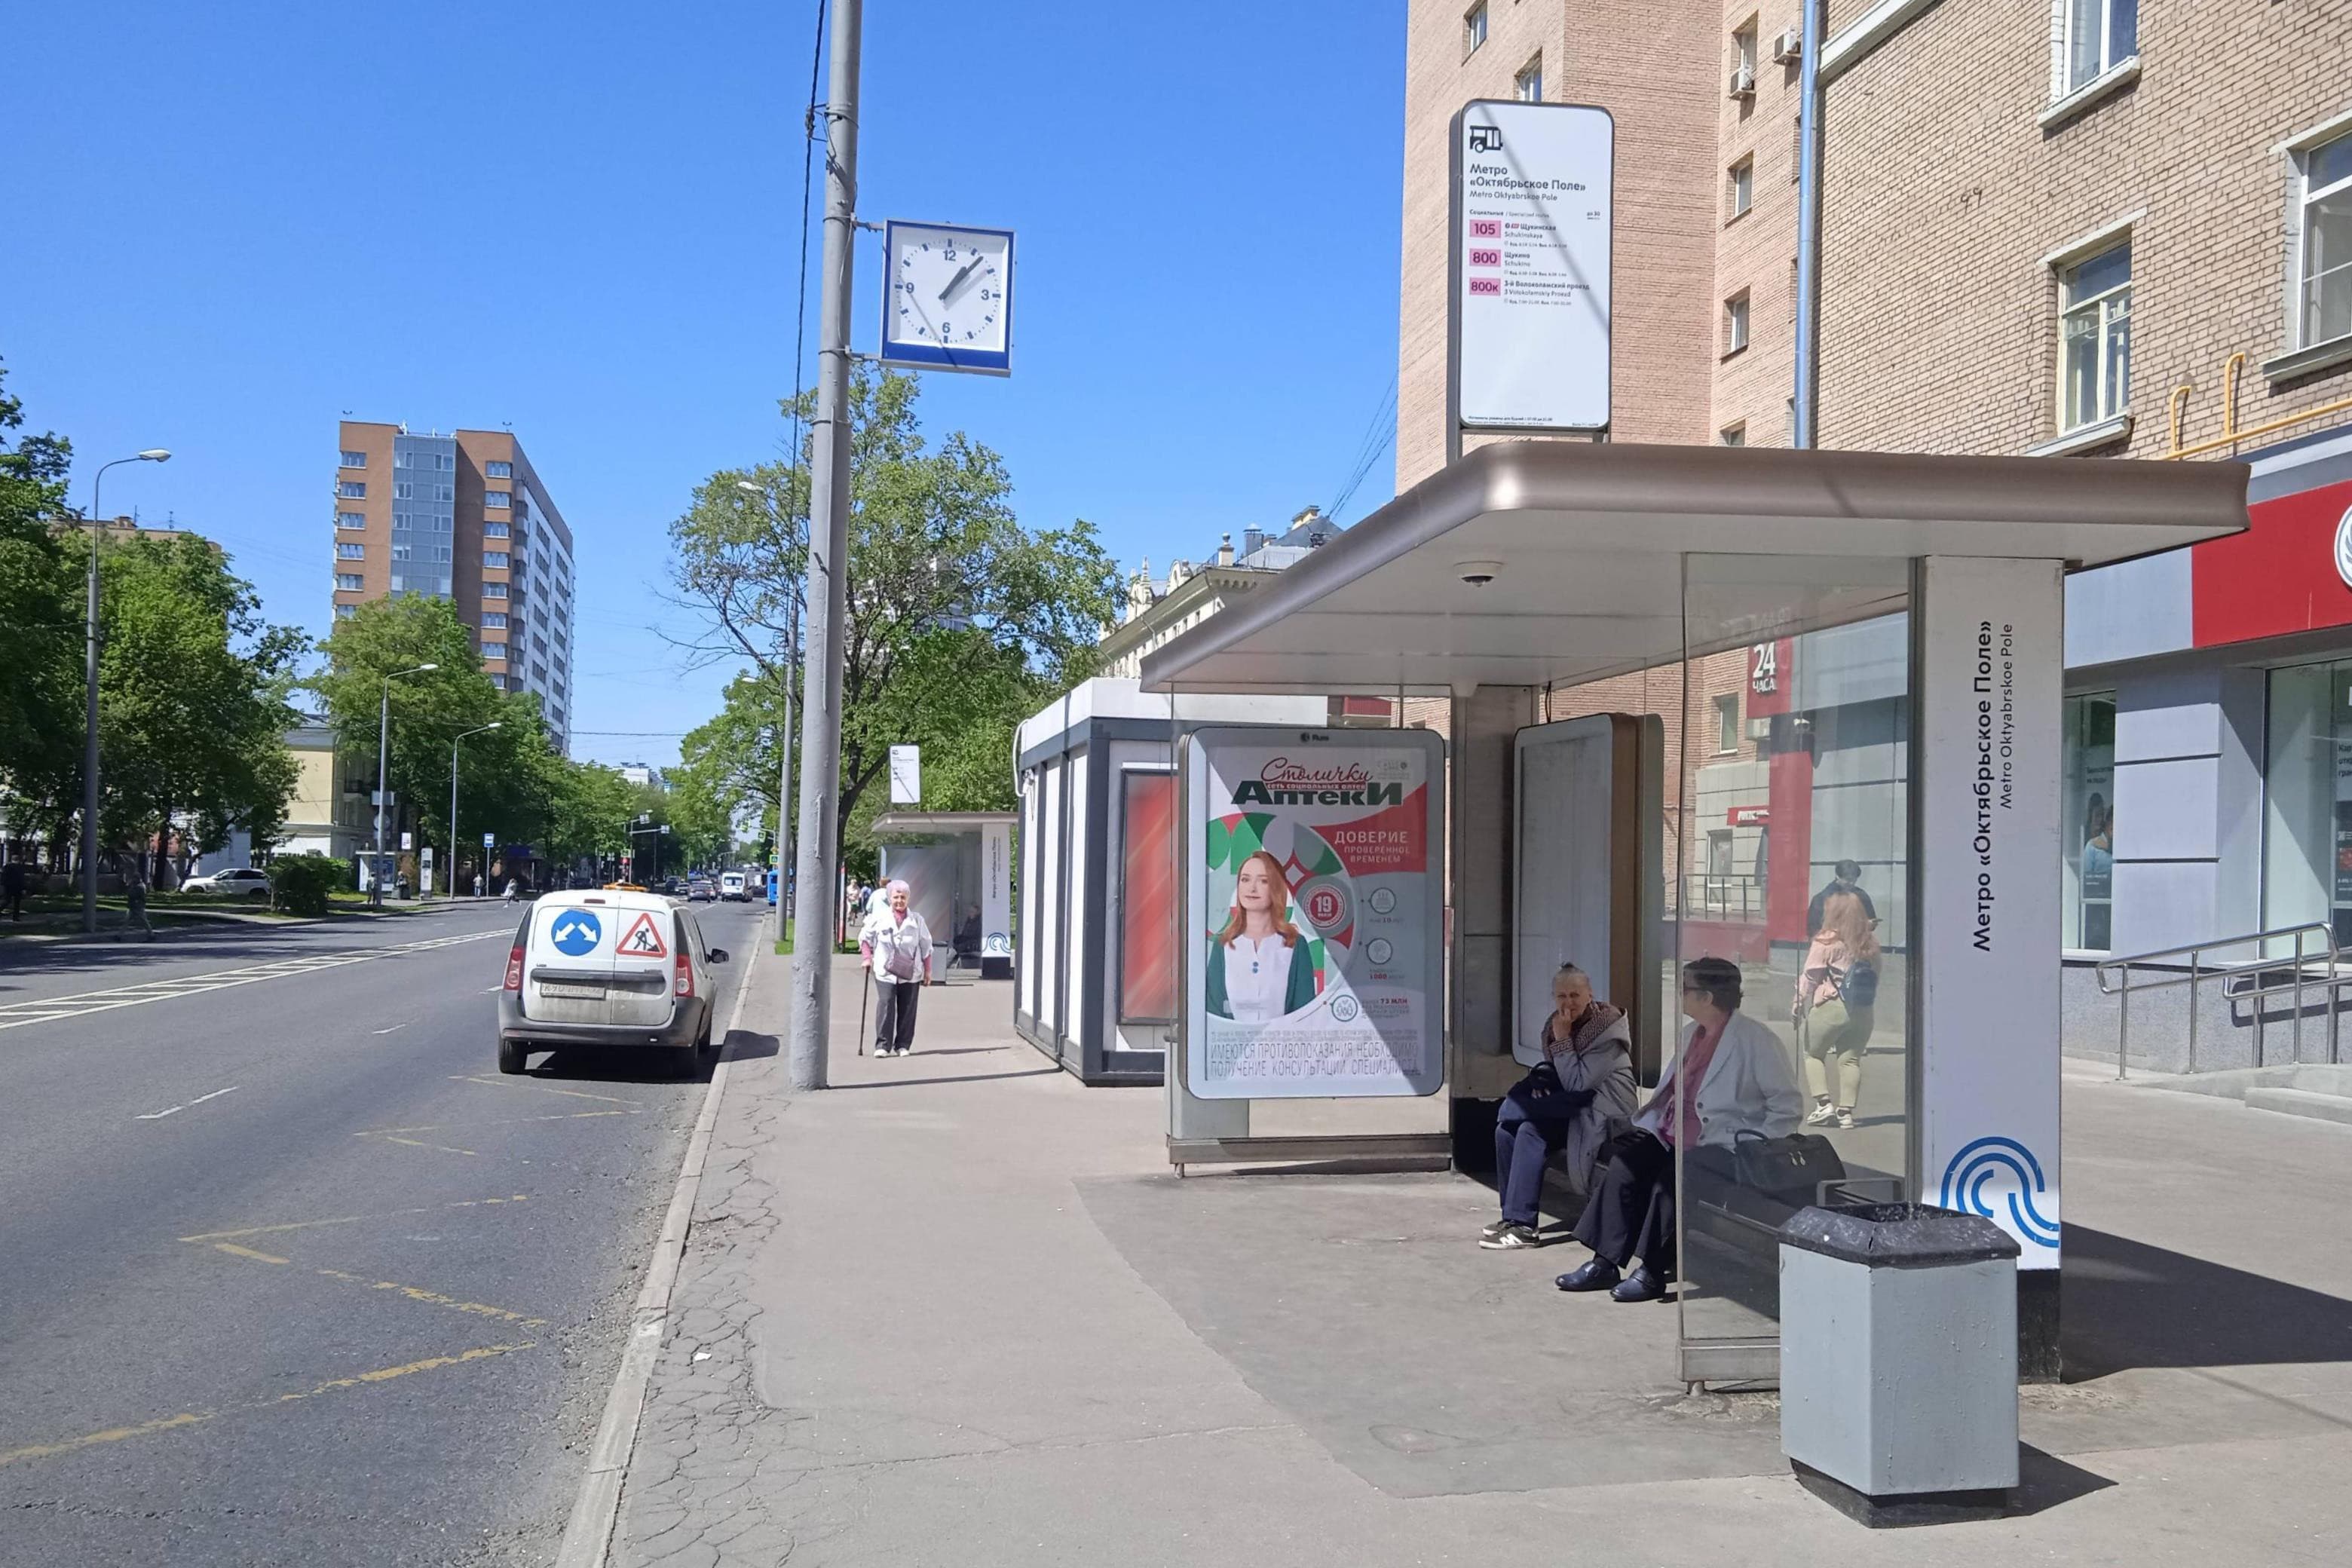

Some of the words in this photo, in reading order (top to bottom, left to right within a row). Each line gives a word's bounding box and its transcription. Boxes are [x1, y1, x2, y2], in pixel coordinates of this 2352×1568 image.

[1470, 163, 1508, 177] Метро
[1470, 176, 1548, 189] «Октябрьское
[1551, 179, 1585, 191] Поле»
[1470, 190, 1493, 199] Metro
[1494, 191, 1540, 201] Oktyabrskoe
[1542, 193, 1557, 202] Pole
[1475, 223, 1496, 235] 105
[1521, 223, 1557, 231] Щукинская
[943, 250, 956, 262] 12
[1473, 253, 1497, 264] 800
[906, 282, 914, 294] 9
[981, 289, 989, 301] 3
[1472, 281, 1499, 292] 800к
[942, 322, 951, 333] 6
[2000, 623, 2013, 657] Pole
[1753, 642, 1775, 678] 24
[1974, 620, 1992, 693] Поле»
[1753, 678, 1776, 693] ЧАСА
[2000, 661, 2015, 757] Oktyabrskoe
[1260, 757, 1374, 782] Столички
[1974, 700, 1995, 865] «Октябрьское
[2000, 761, 2013, 809] Metro
[1334, 831, 1408, 844] ДОВЕРИЕ
[1344, 846, 1410, 854] ПРОВЕРЕННОЕ
[1350, 855, 1401, 863] ВРЕМЕНЕМ
[1315, 896, 1332, 912] 19
[1974, 873, 1995, 951] Метро
[1211, 1043, 1255, 1059] ИМЕЮТСЯ
[1257, 1043, 1352, 1058] ПРОТИВОПОКАЗАНИЯ
[1211, 1060, 1266, 1076] ПОЛУЧЕНИЕ
[1272, 1059, 1346, 1076] КОНСУЛЬТАЦИИ
